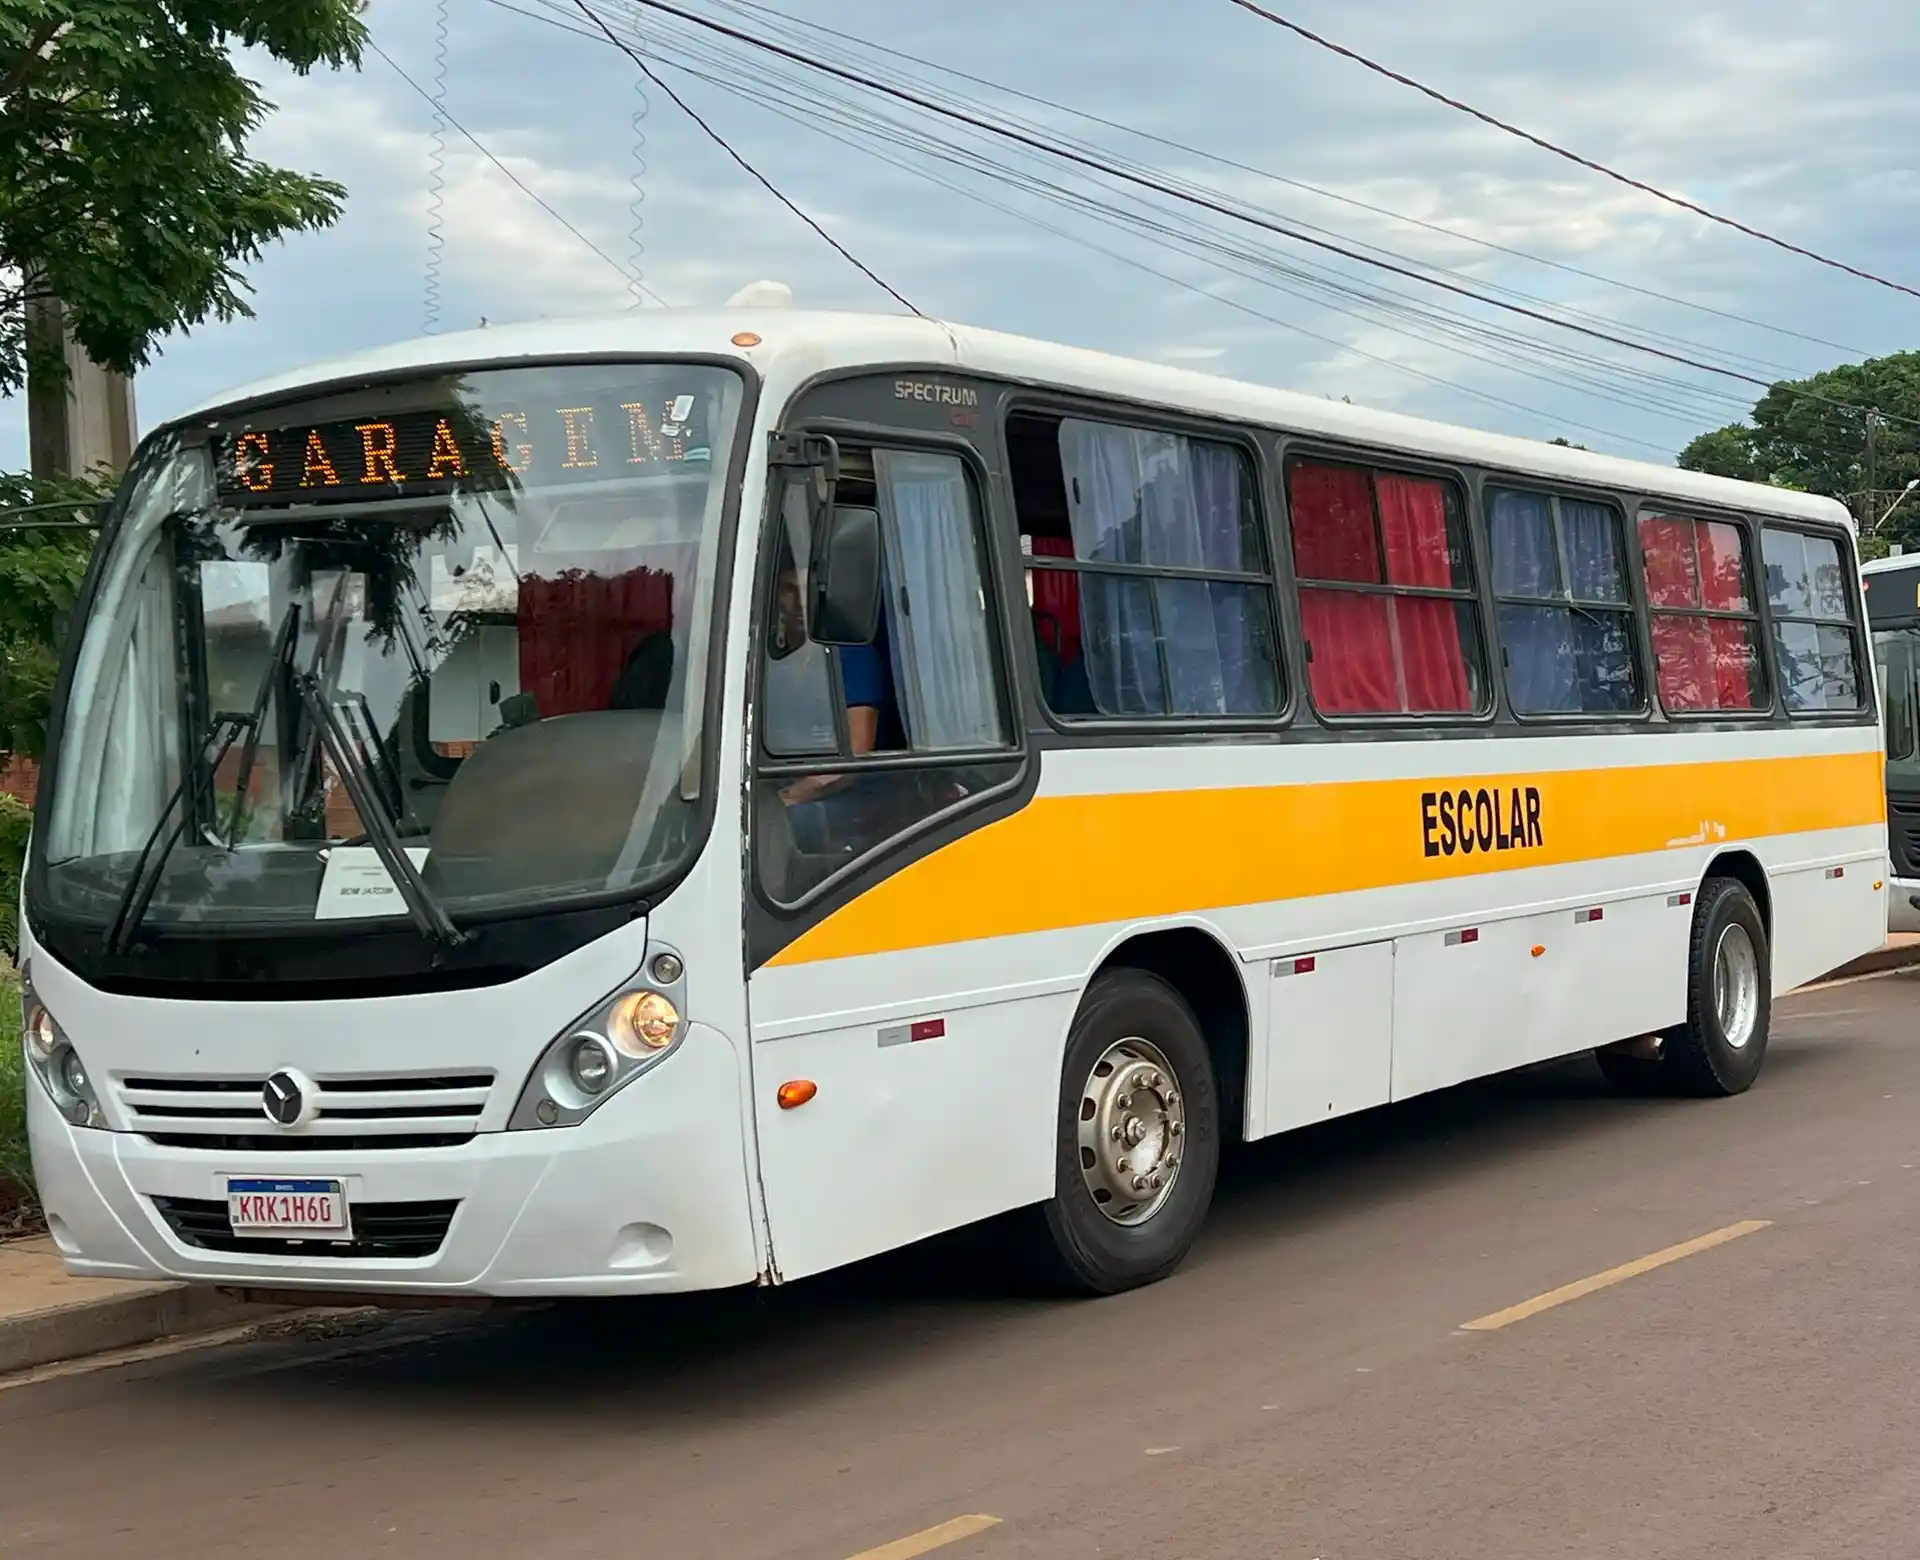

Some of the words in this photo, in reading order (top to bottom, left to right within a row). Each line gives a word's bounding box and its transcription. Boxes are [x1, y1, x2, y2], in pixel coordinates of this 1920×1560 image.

[894, 380, 978, 406] SPECTRUM
[235, 399, 684, 491] GARAGEM
[1421, 787, 1543, 858] ESCOLAR
